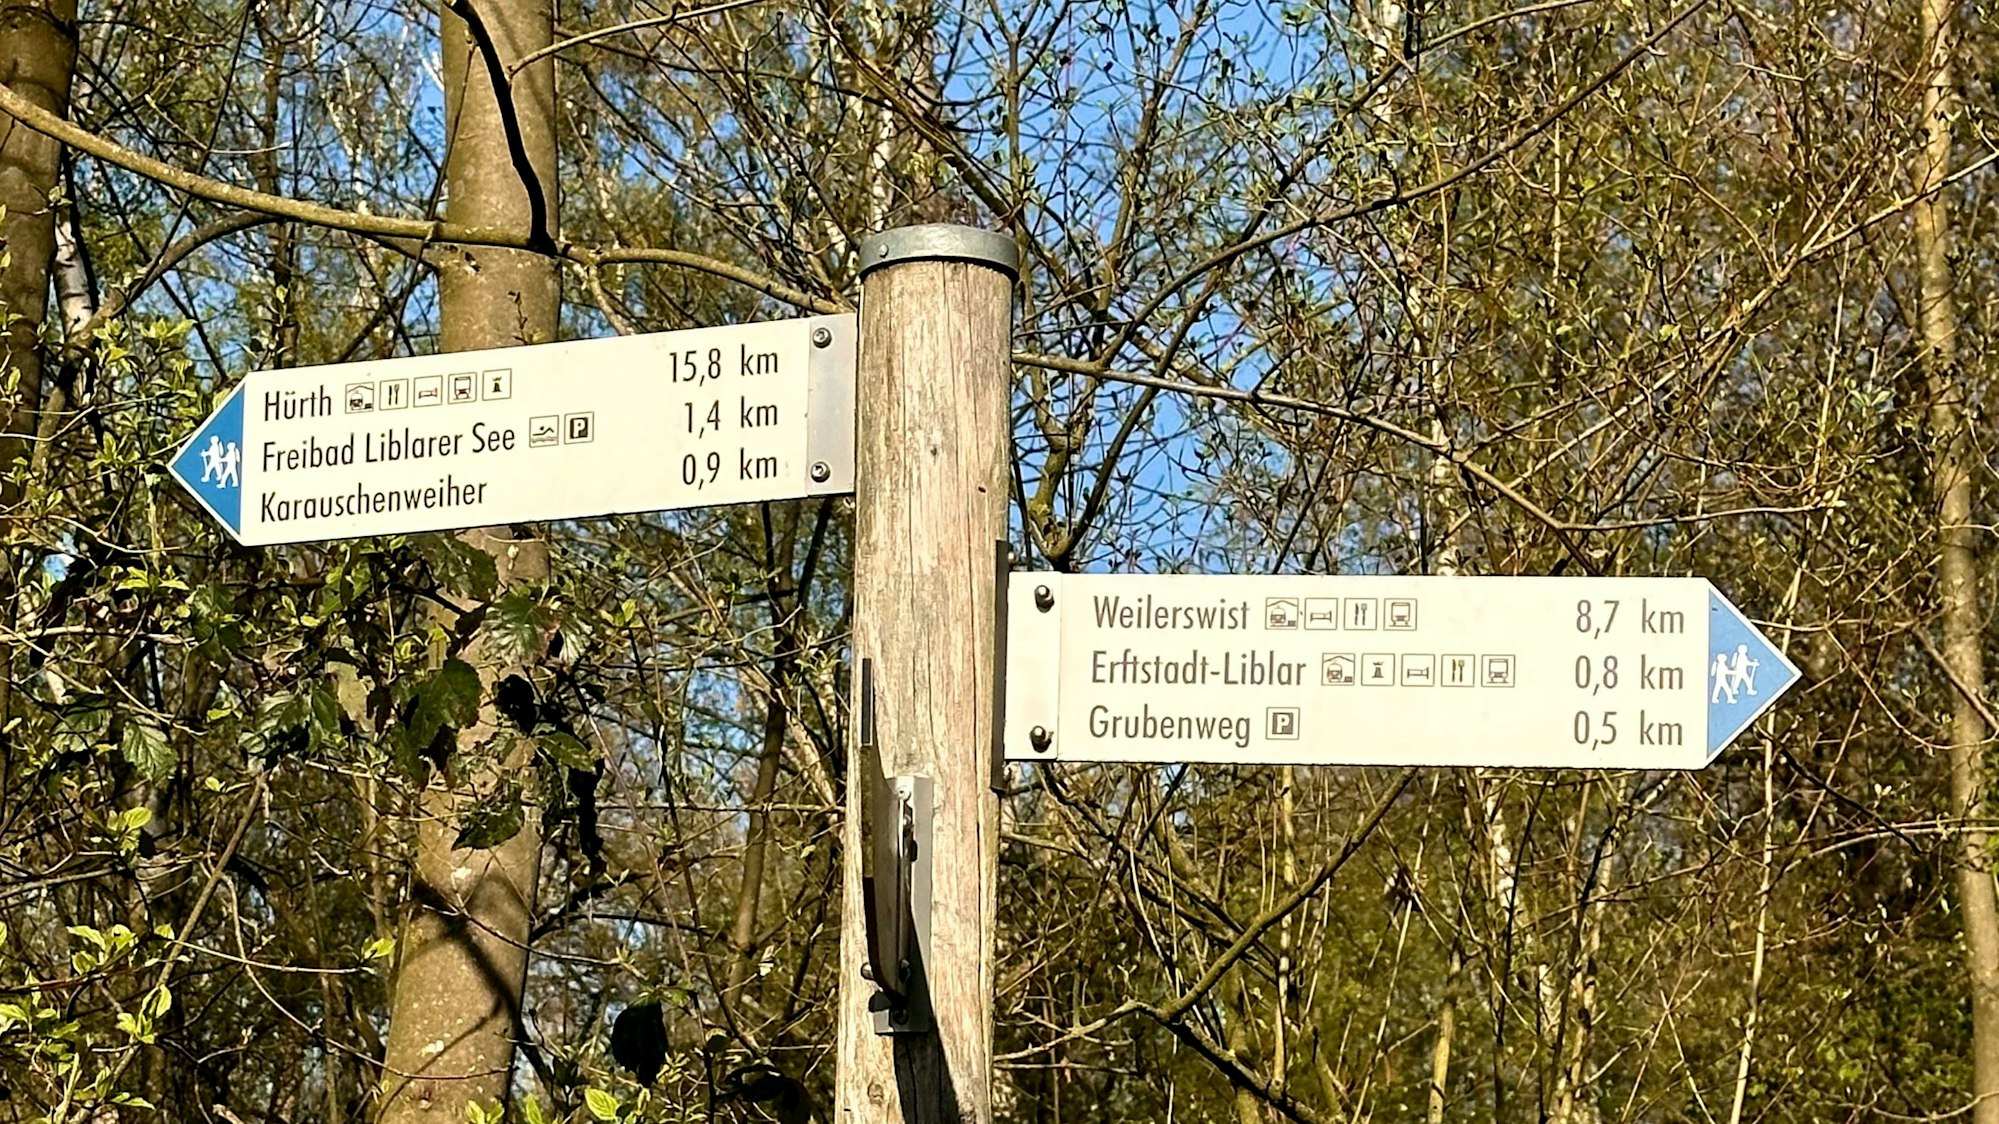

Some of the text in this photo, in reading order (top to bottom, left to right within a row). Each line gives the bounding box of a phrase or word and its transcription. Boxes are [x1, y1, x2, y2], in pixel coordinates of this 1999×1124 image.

[263, 343, 778, 422] Hürth 15,8 km
[262, 433, 354, 472] Freibad
[365, 427, 463, 463] Liblarer
[471, 422, 515, 454] See
[684, 399, 721, 439] 1,4
[740, 395, 778, 428] km
[260, 447, 777, 523] Karauschenweiher 0,9 km
[1093, 594, 1685, 640] Weilerswist 8,7 km
[1091, 648, 1684, 696] Erftstadt-Liblar 0,8 km
[1088, 703, 1251, 748] Grubenweg
[1573, 710, 1617, 751] 0,5
[1639, 709, 1683, 746] km
